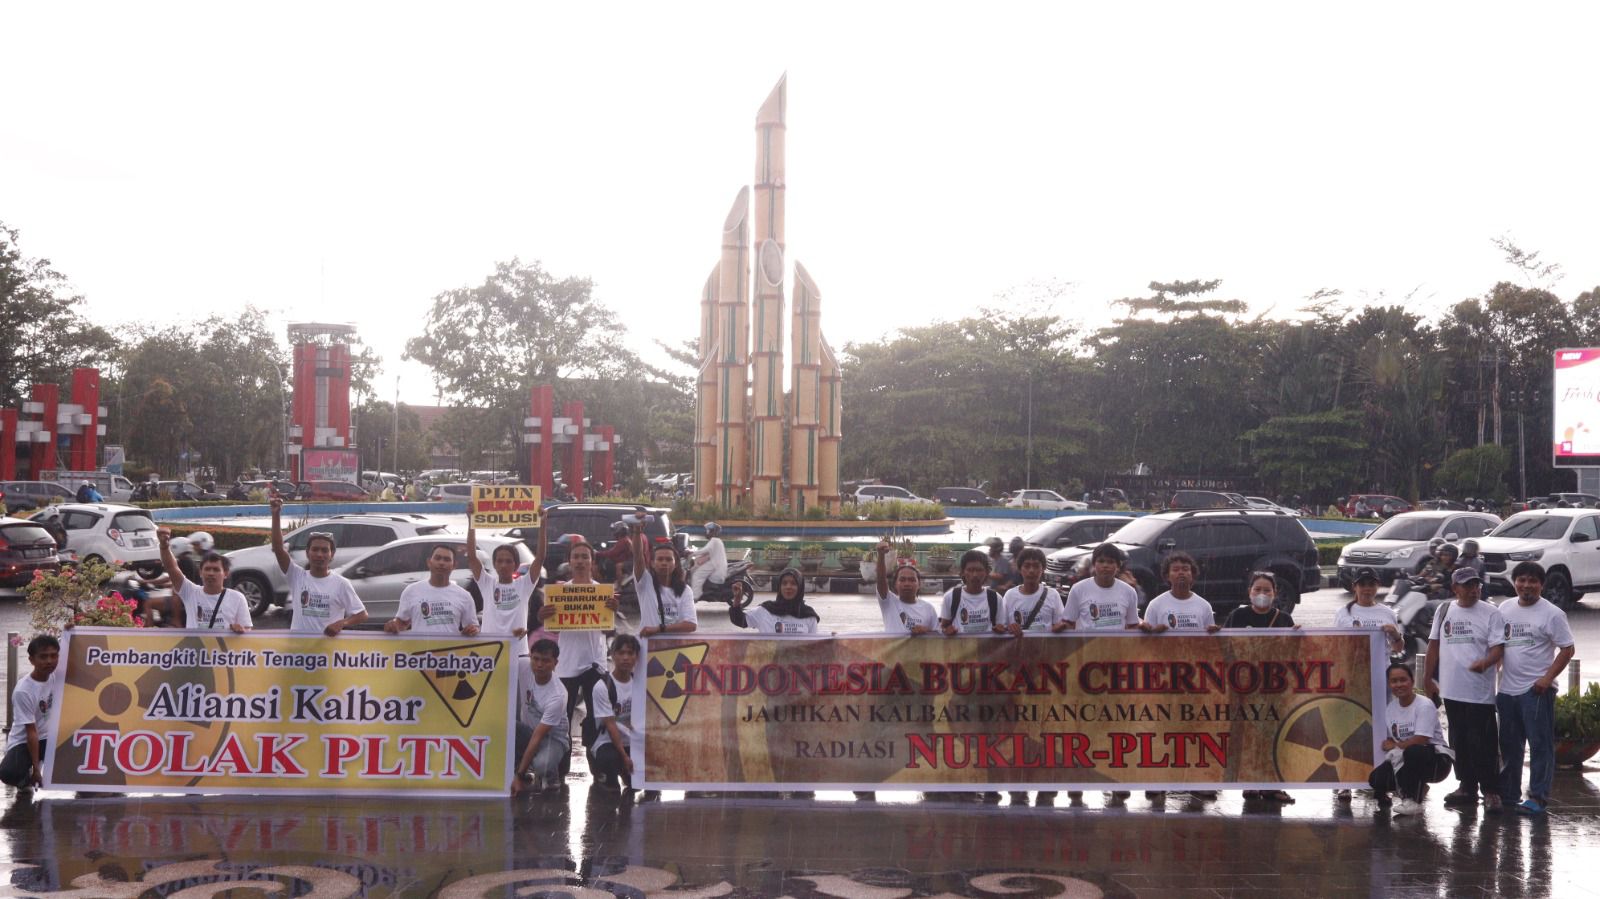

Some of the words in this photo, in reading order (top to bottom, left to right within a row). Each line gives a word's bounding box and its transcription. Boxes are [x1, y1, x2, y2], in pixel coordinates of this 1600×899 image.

[479, 487, 534, 499] PLTN
[477, 500, 535, 513] BUKAN
[474, 513, 538, 524] SOLUSI
[549, 595, 611, 603] TERBARUKAN
[558, 613, 601, 625] PLTN
[87, 649, 195, 669] Pembangkit
[201, 650, 256, 666] Listrik
[263, 651, 327, 669] Tenaga
[334, 652, 388, 668] Nuklir
[394, 653, 493, 673] Berbahaya
[682, 662, 915, 696] INDONESIA
[919, 661, 1069, 696] BUKAN
[1077, 660, 1346, 695] CHERNOBYL
[147, 685, 279, 720] Aliansi
[294, 688, 422, 722] Kalbar
[742, 704, 861, 724] JAUHKAN
[869, 704, 971, 723] KALBAR
[978, 704, 1039, 722] DARI
[1044, 703, 1172, 722] ANCAMAN
[1180, 703, 1280, 722] BAHAYA
[76, 732, 306, 775] TOLAK
[321, 736, 488, 778] PLTN
[795, 739, 896, 760] RADIASI
[904, 731, 1231, 770] NUKLIR-PLTN
